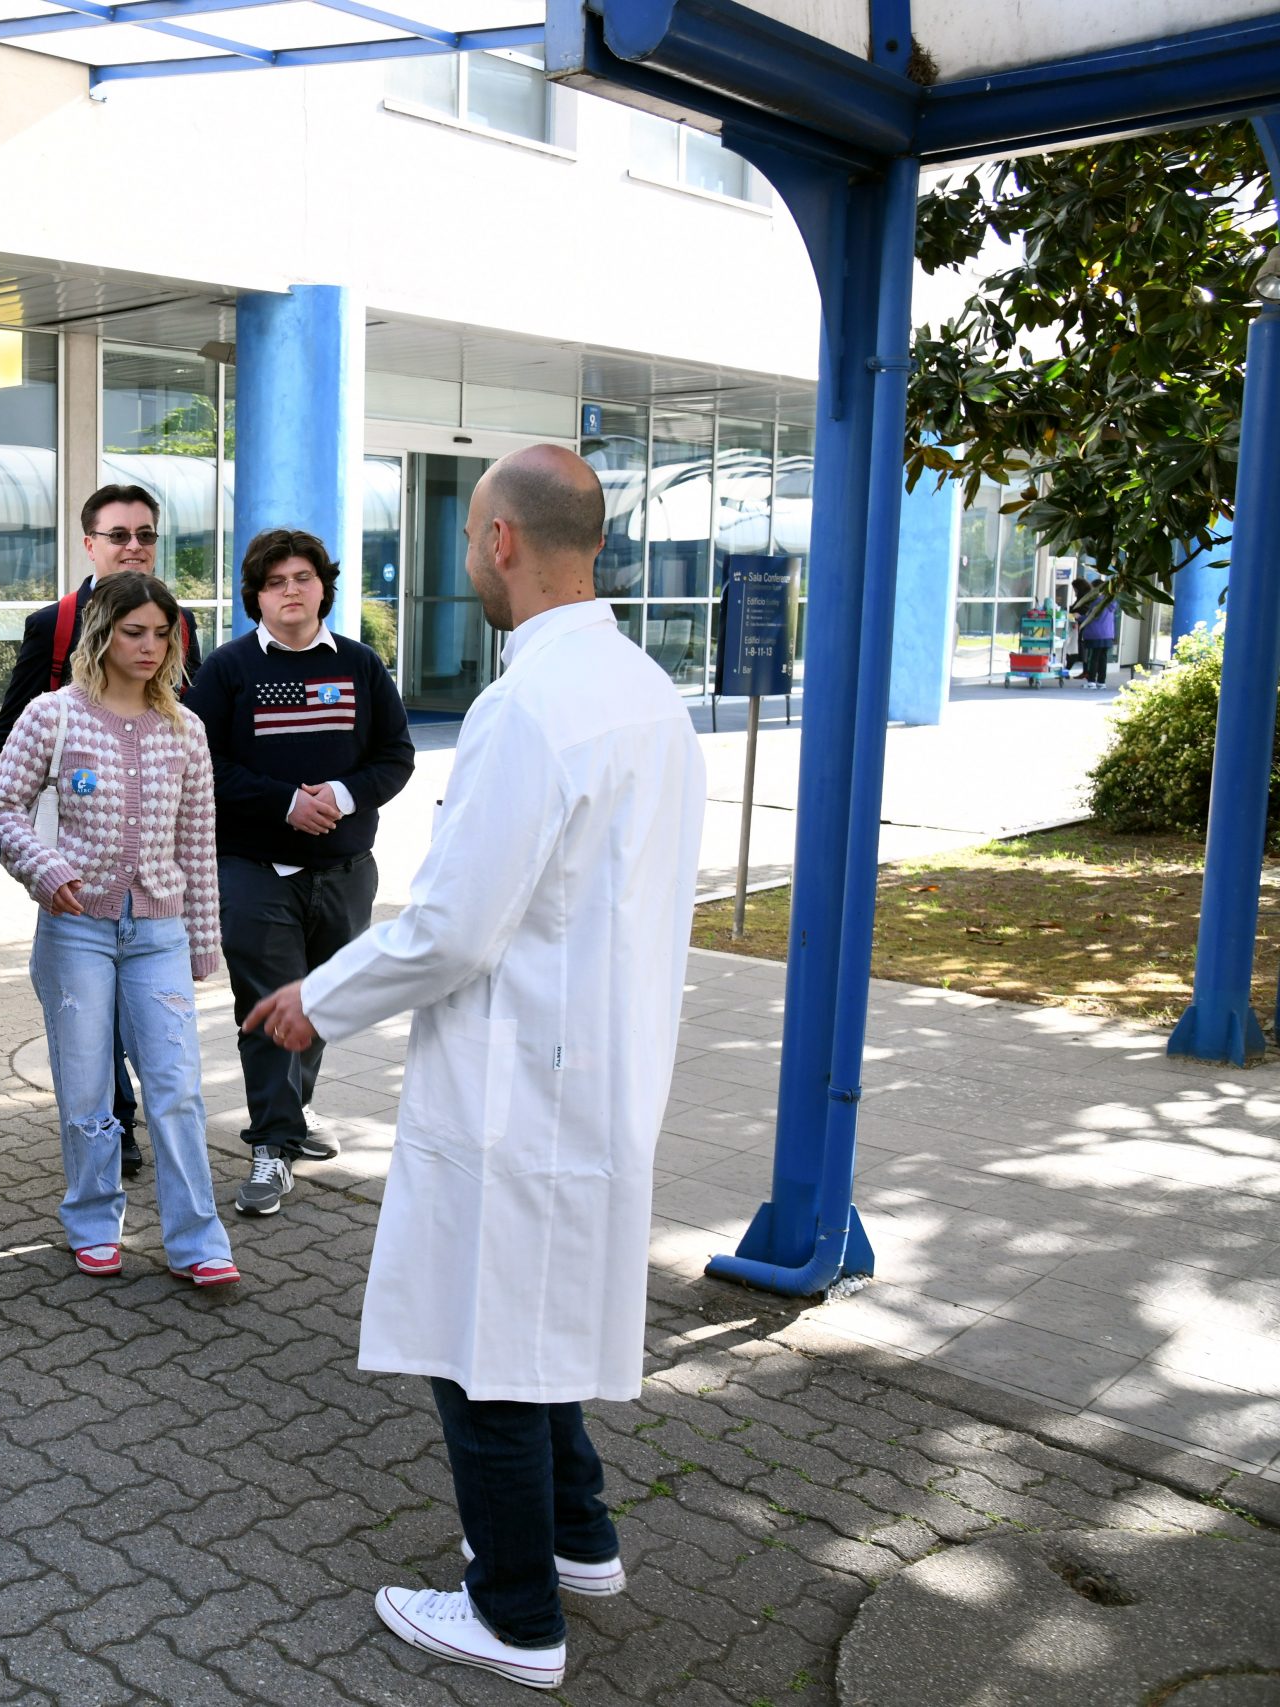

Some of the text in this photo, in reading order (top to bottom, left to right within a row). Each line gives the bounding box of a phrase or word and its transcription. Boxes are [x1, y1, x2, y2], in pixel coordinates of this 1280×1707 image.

[748, 572, 762, 582] Sala
[745, 647, 772, 656] 1-8-11-13
[742, 666, 752, 674] Bar
